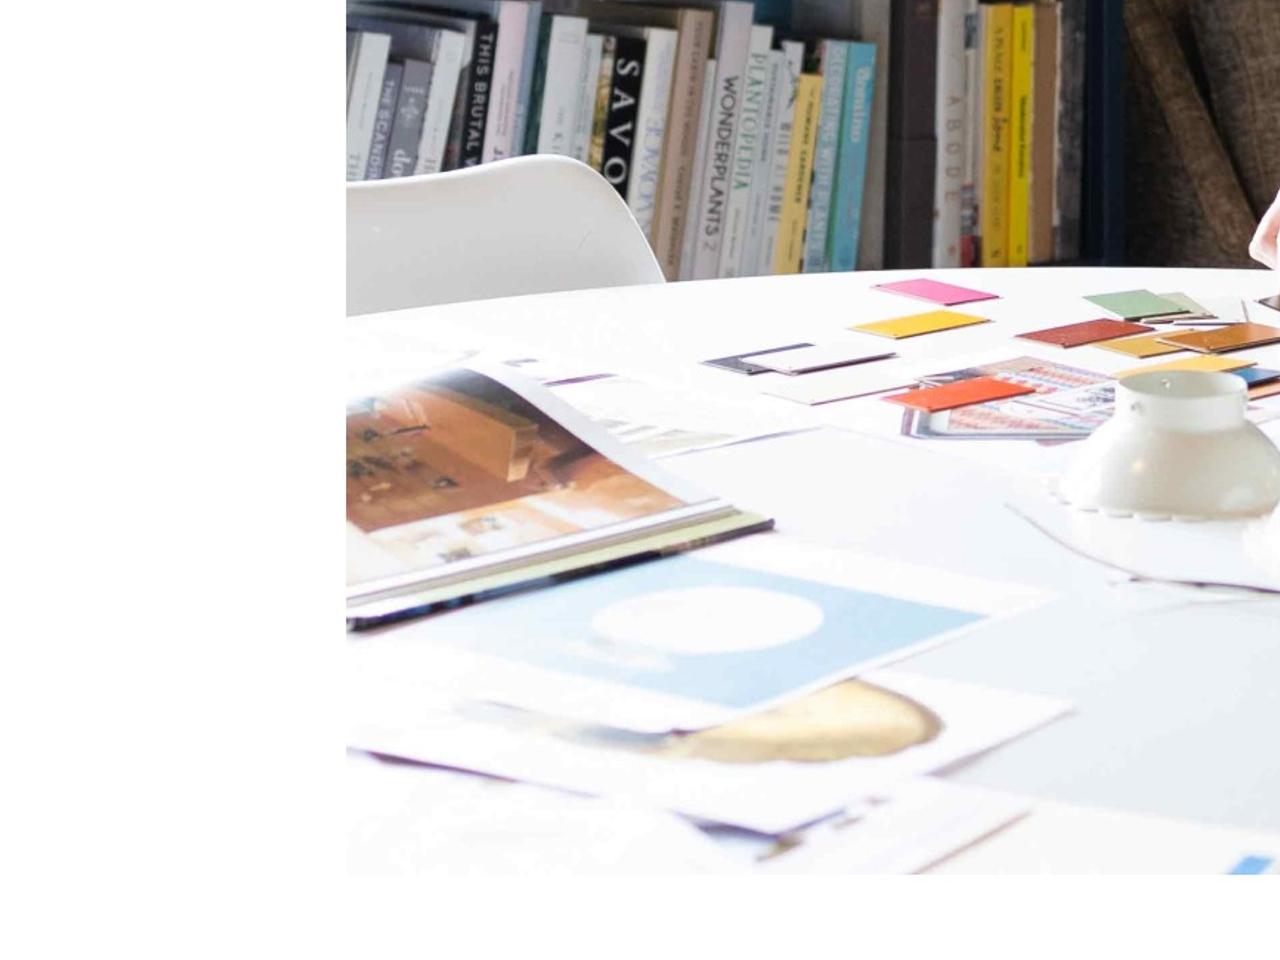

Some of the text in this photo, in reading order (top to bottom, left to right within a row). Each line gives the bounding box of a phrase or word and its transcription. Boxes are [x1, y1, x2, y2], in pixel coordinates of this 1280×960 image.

[474, 31, 496, 75] THIS
[466, 81, 489, 151] BRUTAL
[705, 75, 739, 237] WONDERPLANTS
[734, 53, 766, 192] PLANTOPEDIA
[945, 94, 962, 205] ABODE
[703, 241, 716, 252] 2
